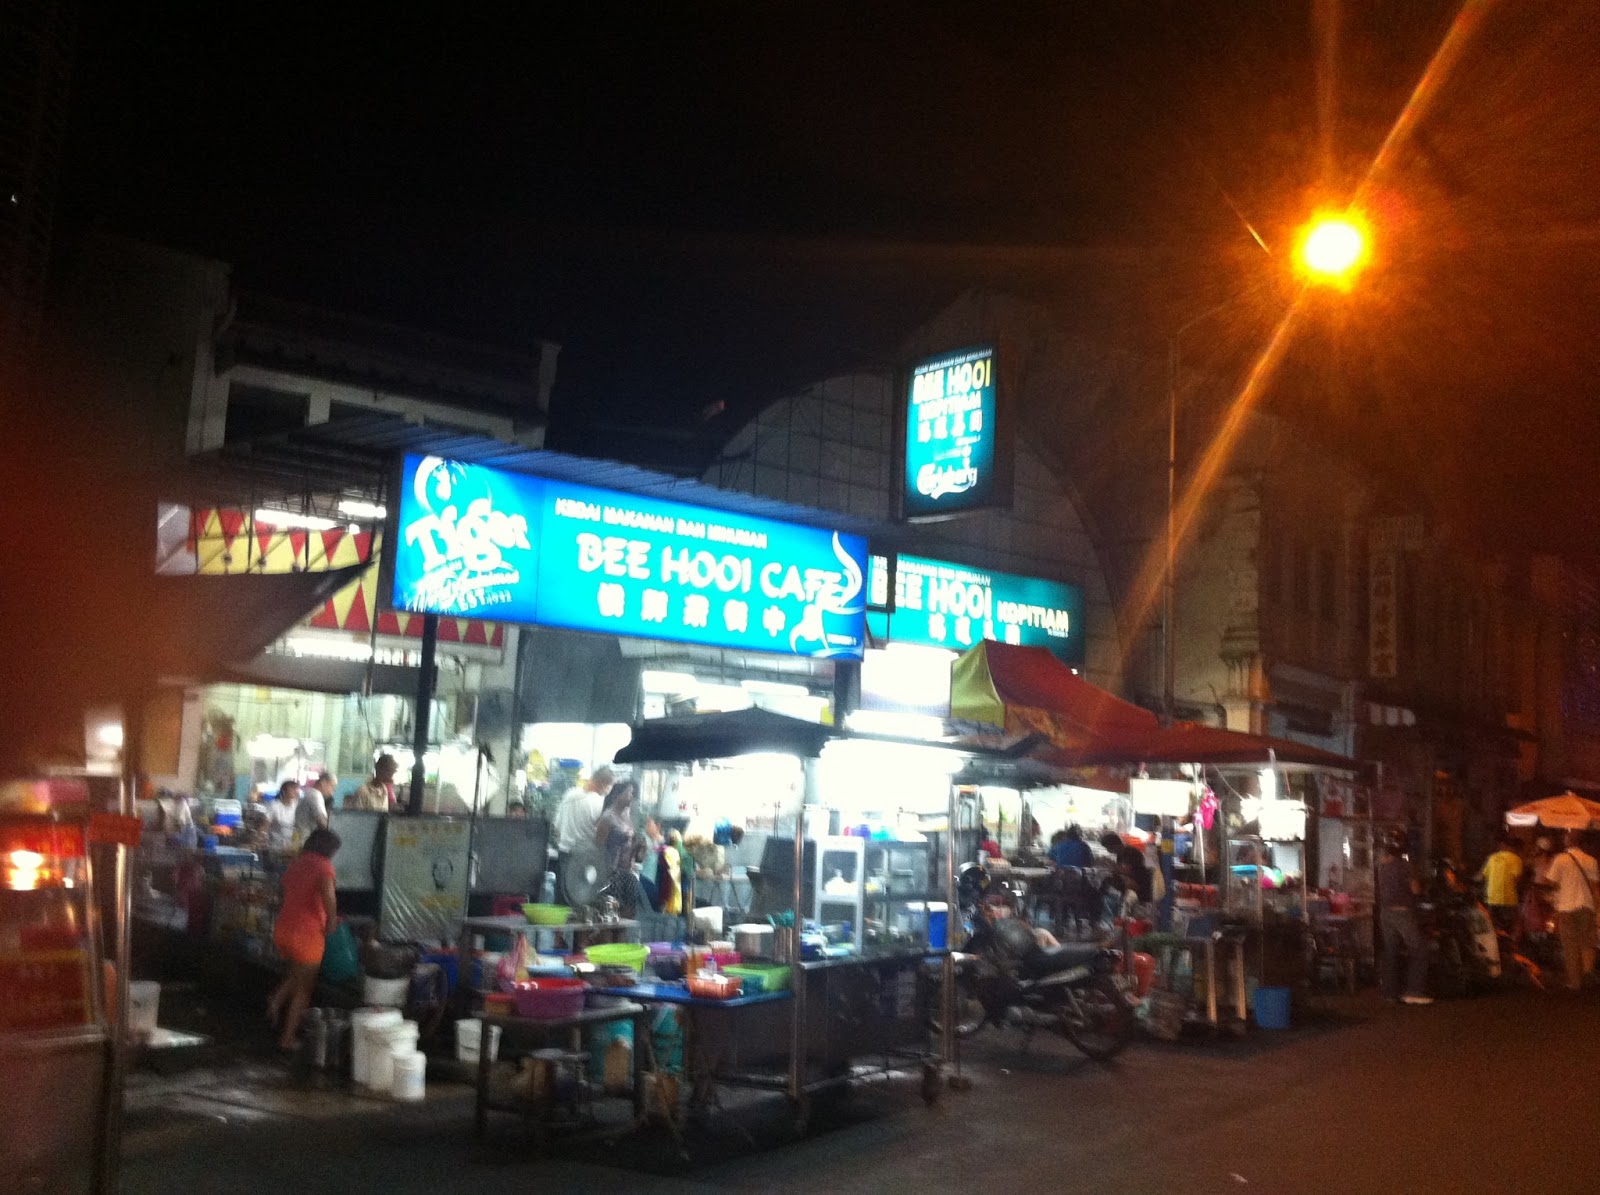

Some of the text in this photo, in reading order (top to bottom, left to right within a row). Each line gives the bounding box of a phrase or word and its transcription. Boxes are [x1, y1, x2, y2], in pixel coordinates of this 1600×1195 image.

[946, 357, 992, 397] HOOI
[575, 532, 651, 580] BEE
[661, 545, 752, 594] HOOI
[928, 577, 993, 620] HOOI
[997, 600, 1069, 632] KOPITIAM
